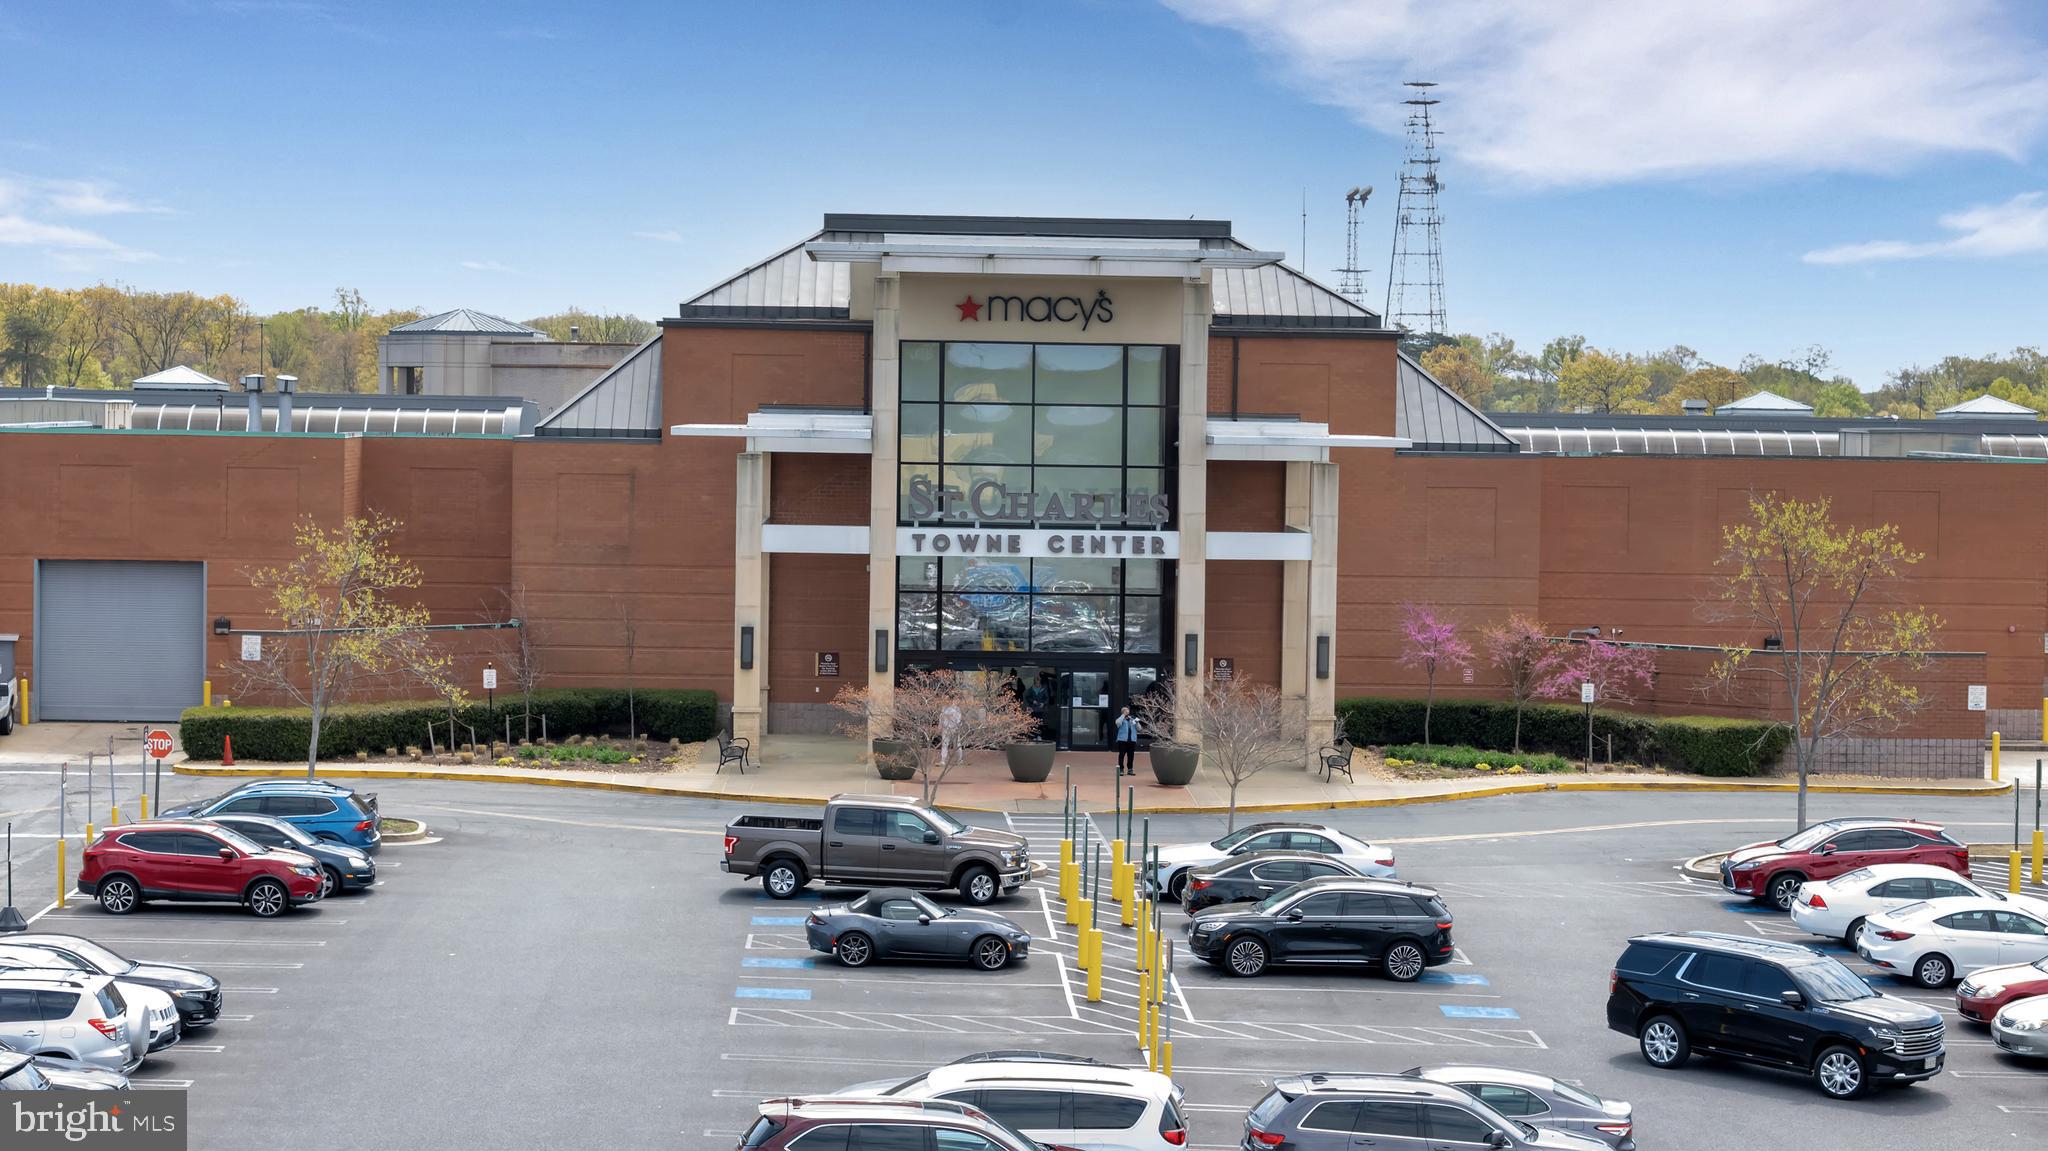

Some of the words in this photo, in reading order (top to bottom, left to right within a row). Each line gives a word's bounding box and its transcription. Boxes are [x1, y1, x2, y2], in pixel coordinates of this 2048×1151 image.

[987, 289, 1113, 331] macy's
[911, 532, 1021, 553] TOWNE
[1047, 534, 1166, 555] CENTER
[147, 738, 171, 750] STOP
